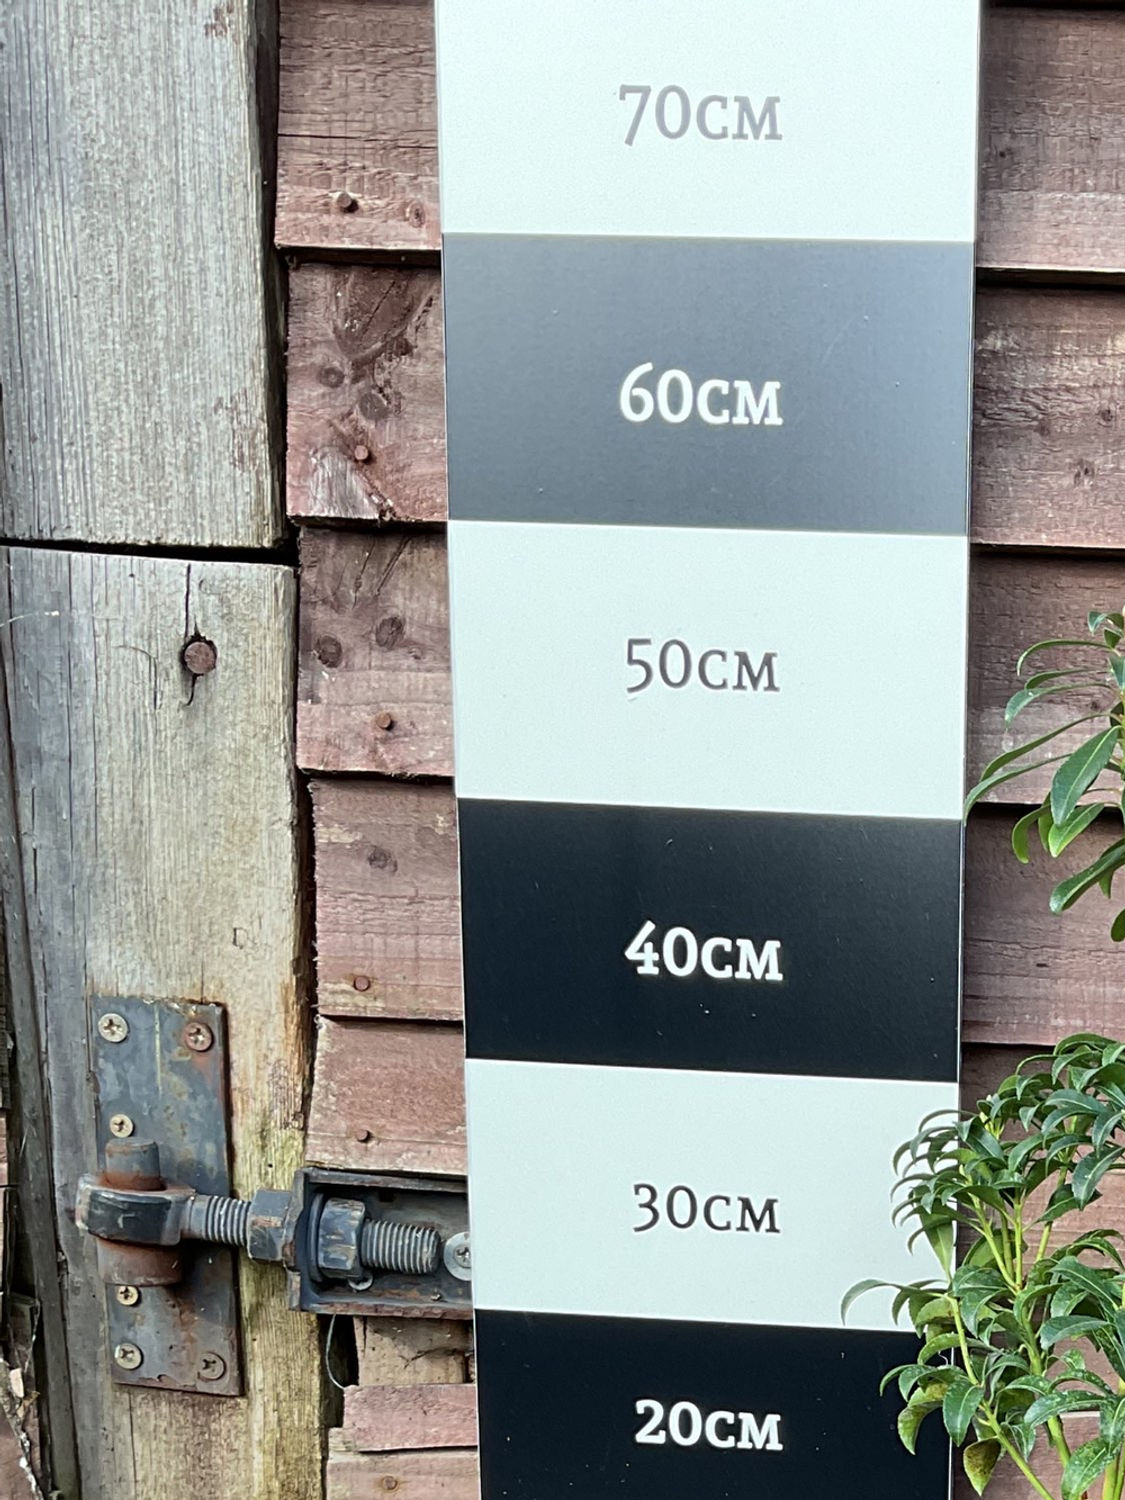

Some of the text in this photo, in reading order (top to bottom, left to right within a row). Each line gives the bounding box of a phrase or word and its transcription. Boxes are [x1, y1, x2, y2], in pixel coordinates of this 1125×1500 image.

[618, 84, 783, 147] 70CM
[618, 361, 784, 426] 60CM
[626, 638, 780, 694] 50CM
[624, 920, 784, 982] 40CM
[633, 1183, 781, 1234] 30CM
[634, 1399, 784, 1451] 20CM
